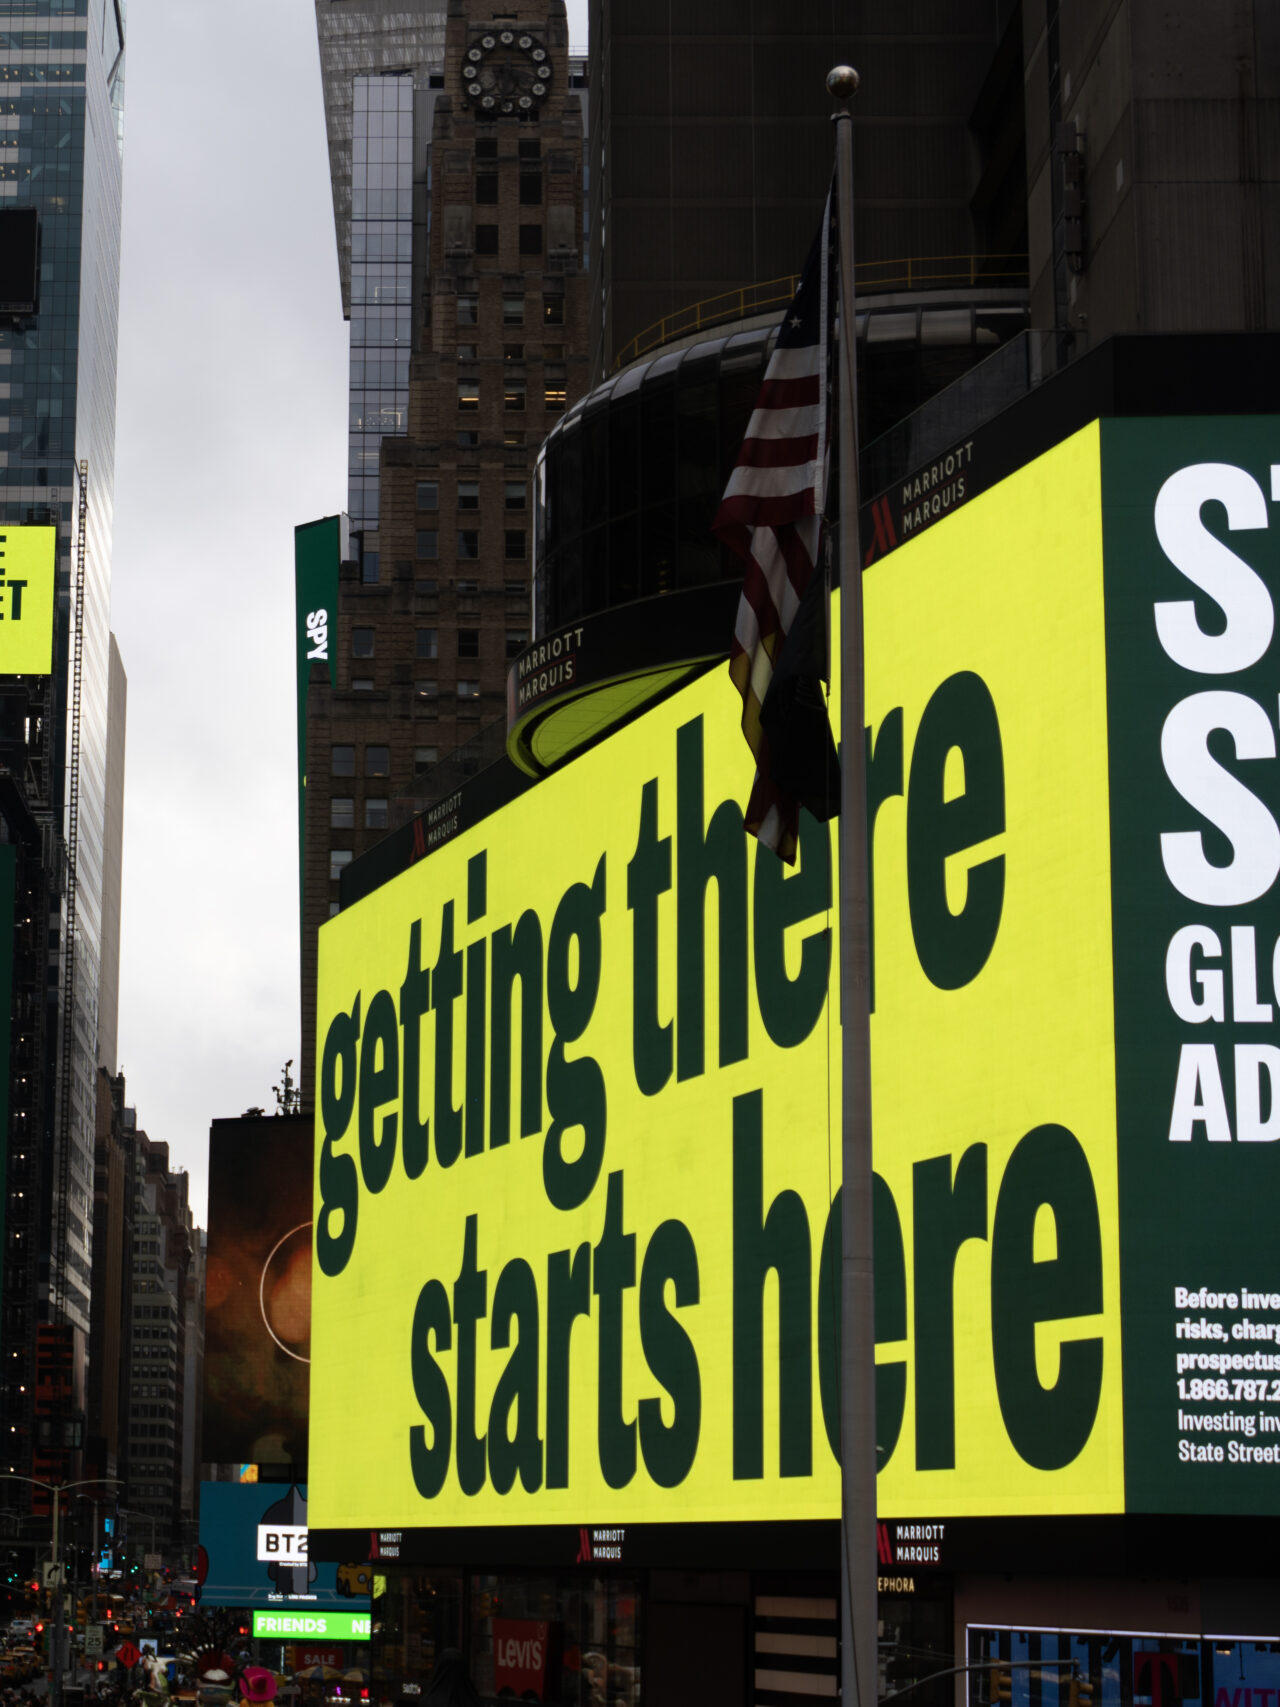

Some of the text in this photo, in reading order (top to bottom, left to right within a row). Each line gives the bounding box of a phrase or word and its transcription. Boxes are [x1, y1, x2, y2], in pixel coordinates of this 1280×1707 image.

[902, 441, 974, 505] MARRIOTT
[903, 478, 966, 534] MARQUIS
[1154, 462, 1280, 674] S
[306, 608, 328, 660] SPY
[519, 627, 584, 679] MARRIOTT
[519, 660, 574, 707] MARQUIS
[428, 792, 462, 824] MARRIOTT
[1157, 690, 1280, 906] S
[428, 816, 458, 846] MARQUIS
[317, 671, 1005, 1277] getting there
[1165, 923, 1280, 1024] GL
[409, 1089, 1103, 1500] starts here
[1174, 1286, 1238, 1309] Before
[1176, 1317, 1229, 1343] risks,
[1176, 1378, 1280, 1402] 1.866.787.2
[1177, 1408, 1256, 1438] Investing
[1178, 1439, 1280, 1463] State Street
[379, 1533, 402, 1544] MARRIOTT
[592, 1529, 626, 1543] MARRIOTT
[896, 1524, 945, 1541] MARRIOTT
[379, 1546, 400, 1557] MARQUIS
[592, 1546, 622, 1560] MARQUIS
[896, 1546, 940, 1562] MARQUIS
[256, 1617, 327, 1633] FRIENDS
[87, 1637, 102, 1647] 25
[304, 1653, 335, 1665] SALE
